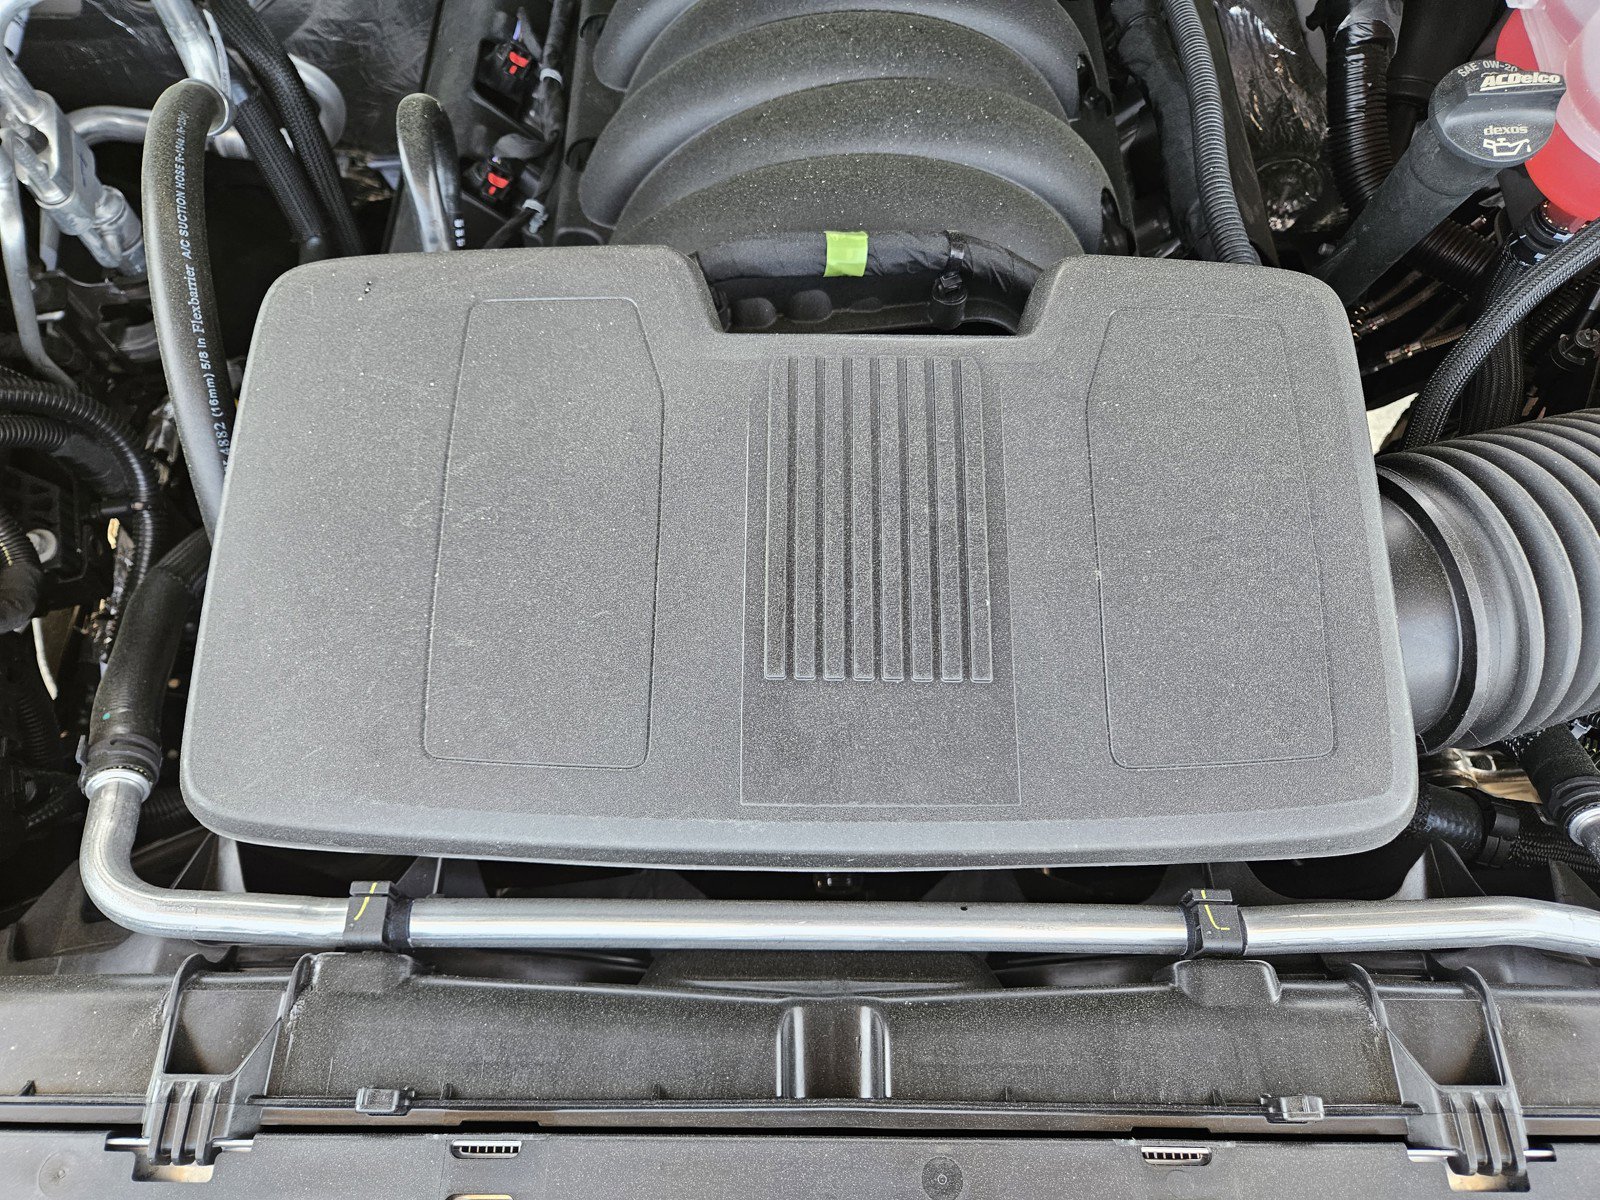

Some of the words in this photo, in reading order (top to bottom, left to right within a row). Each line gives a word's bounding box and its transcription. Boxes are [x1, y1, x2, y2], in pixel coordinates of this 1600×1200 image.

[1457, 62, 1479, 77] SAE
[1482, 60, 1518, 73] 0W-20
[1480, 72, 1561, 88] ACDelco
[1483, 125, 1528, 136] dexos
[174, 163, 186, 189] HOSE
[175, 190, 189, 237] SUCTION
[180, 239, 192, 259] A/C
[184, 264, 205, 334] Flexbarrier
[196, 337, 207, 348] in
[198, 351, 211, 370] 5/8
[203, 373, 224, 417] (16mm)
[213, 422, 230, 456] 4882
